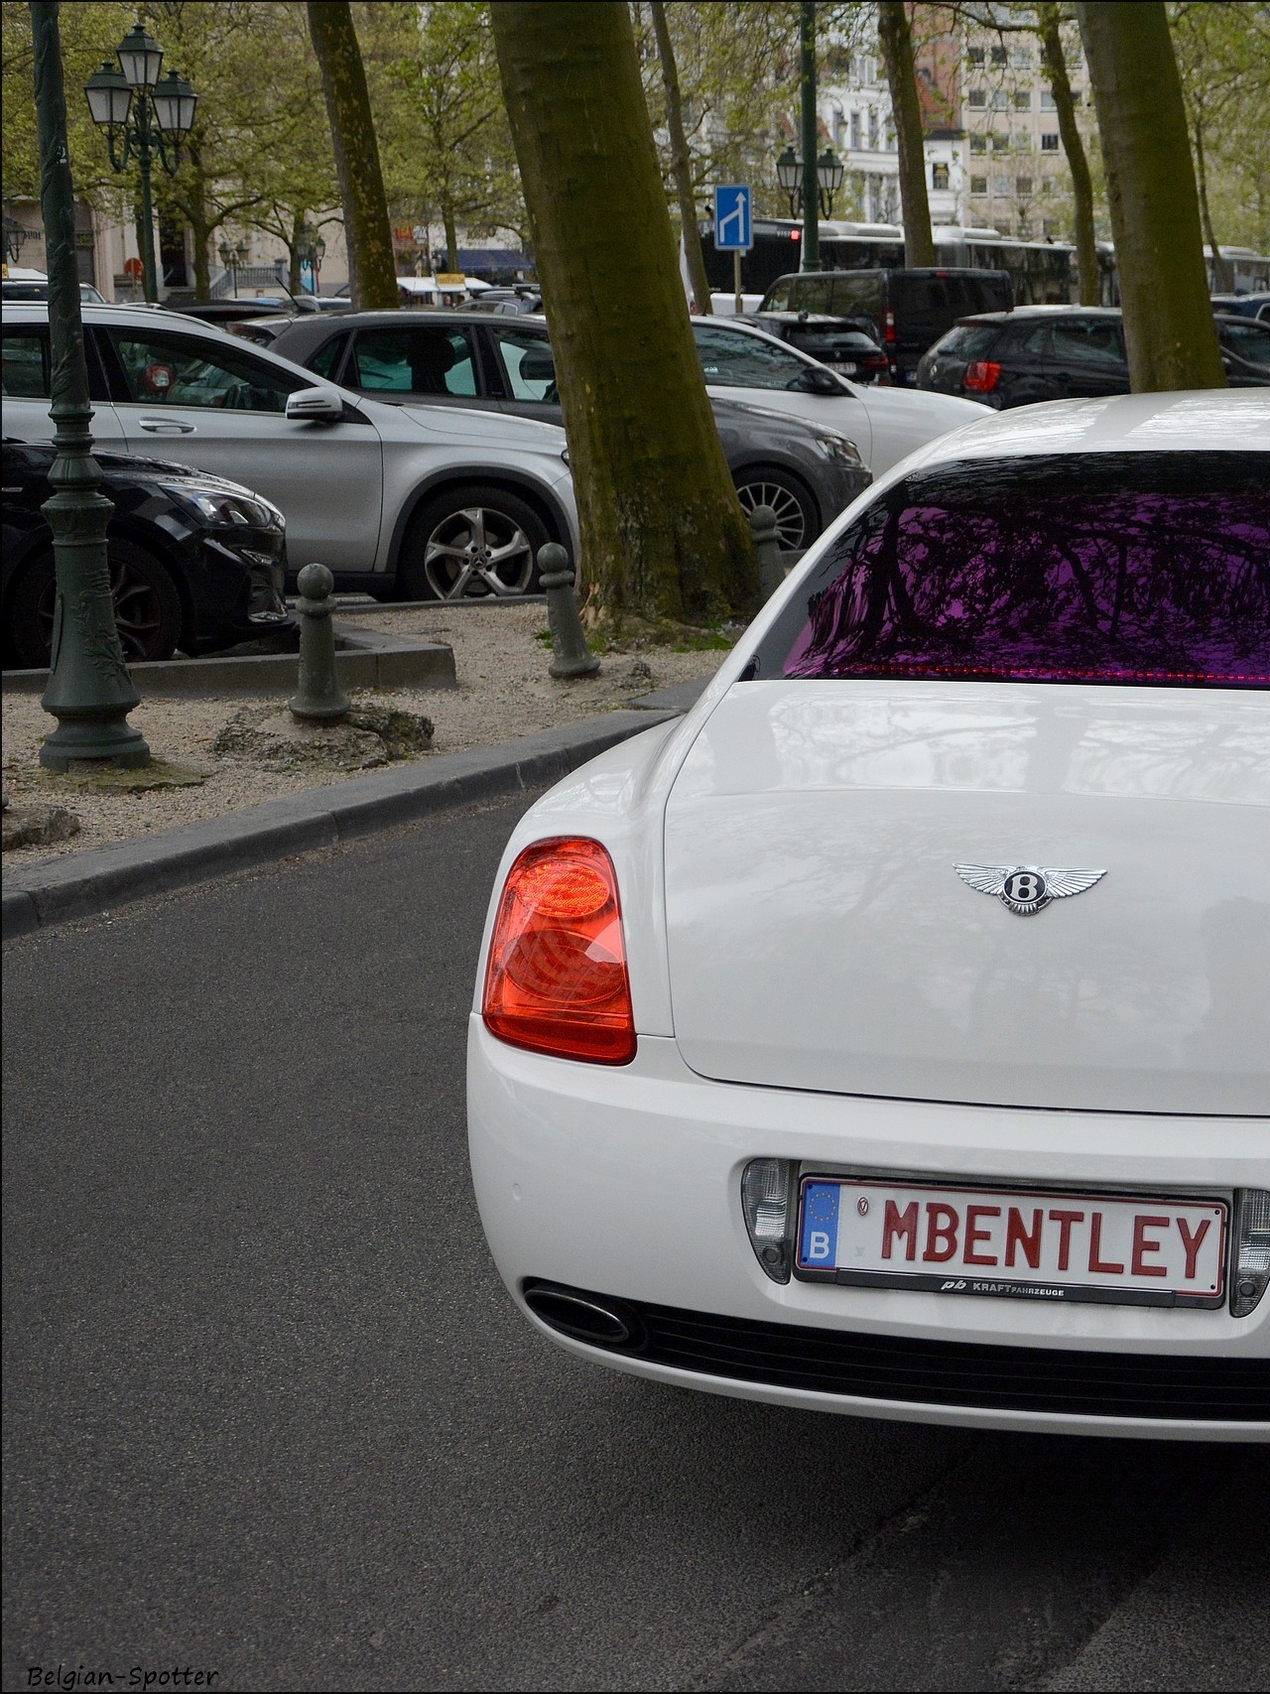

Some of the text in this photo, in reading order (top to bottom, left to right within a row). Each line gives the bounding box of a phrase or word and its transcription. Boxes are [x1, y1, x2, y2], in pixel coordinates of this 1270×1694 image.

[1010, 874, 1038, 901] B
[809, 1231, 829, 1259] B
[881, 1199, 1211, 1279] MBENTLEY
